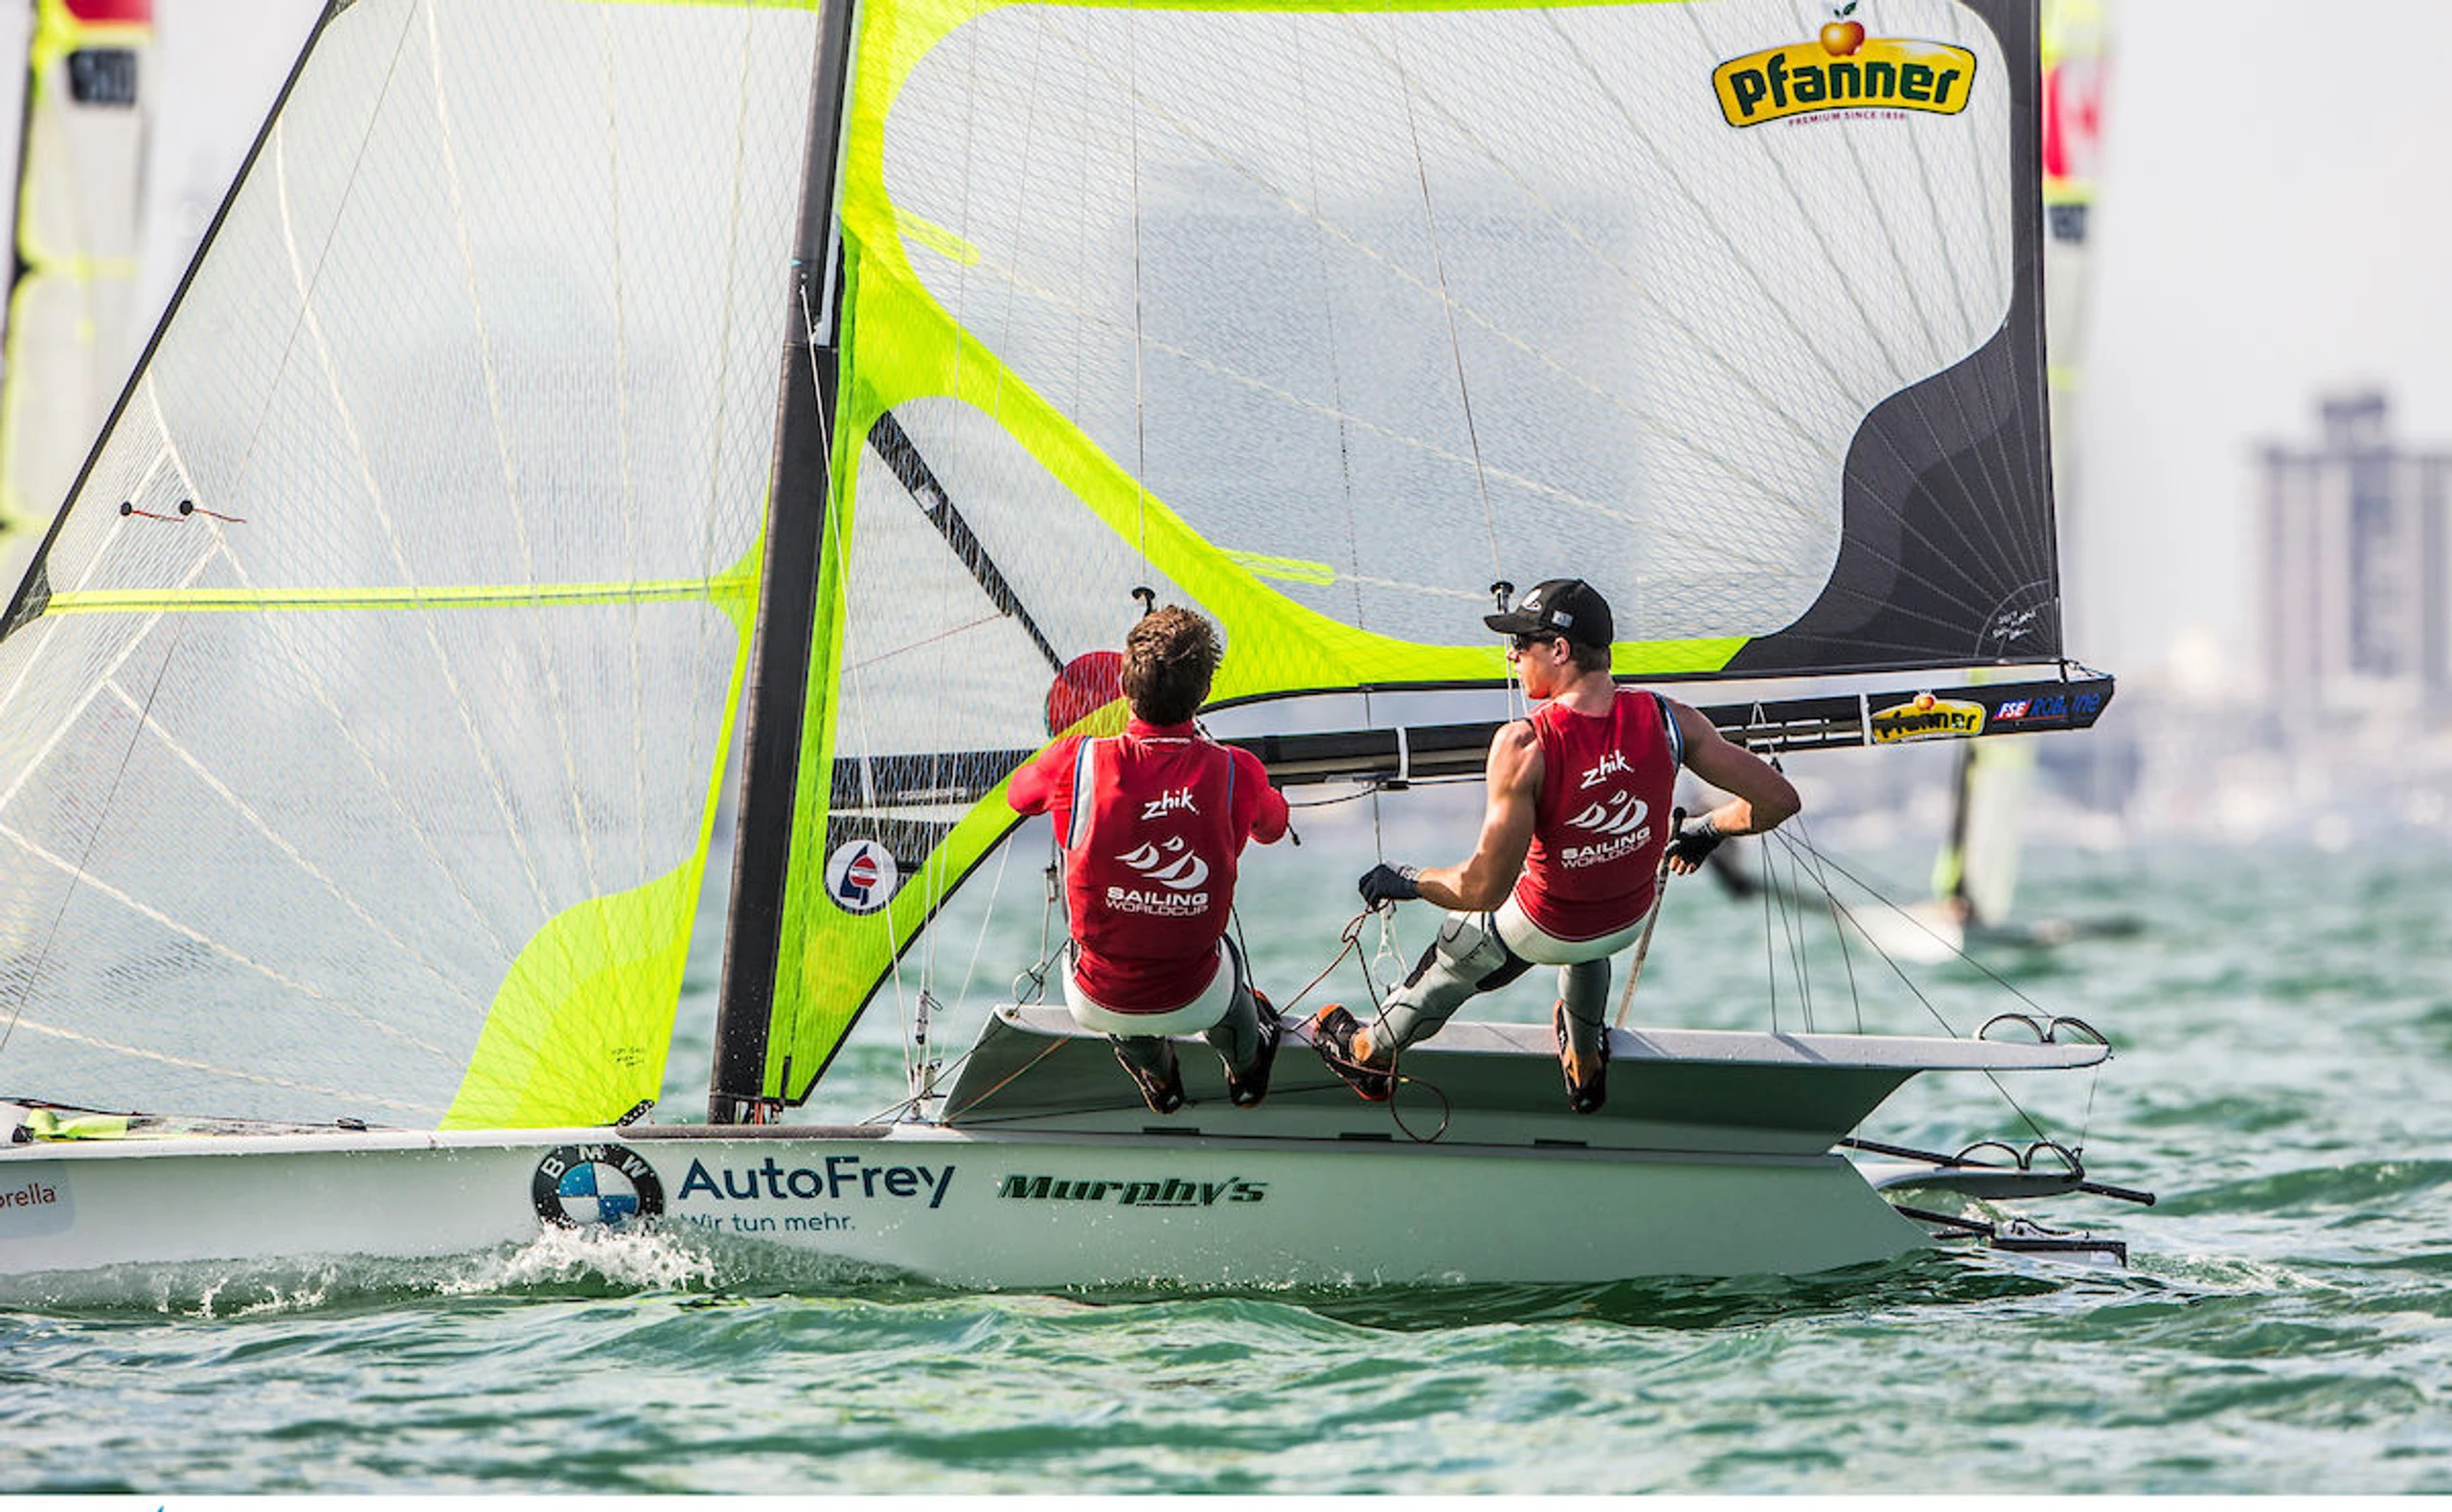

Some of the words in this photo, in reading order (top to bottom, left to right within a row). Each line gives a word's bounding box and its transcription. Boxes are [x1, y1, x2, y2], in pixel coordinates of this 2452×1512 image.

[1560, 825, 1651, 861] SAILING
[1106, 887, 1209, 907] SAILING
[540, 1143, 651, 1181] BMW
[677, 1155, 956, 1208] AutoFrey
[731, 1212, 776, 1232] tun
[783, 1210, 856, 1232] mehr.
